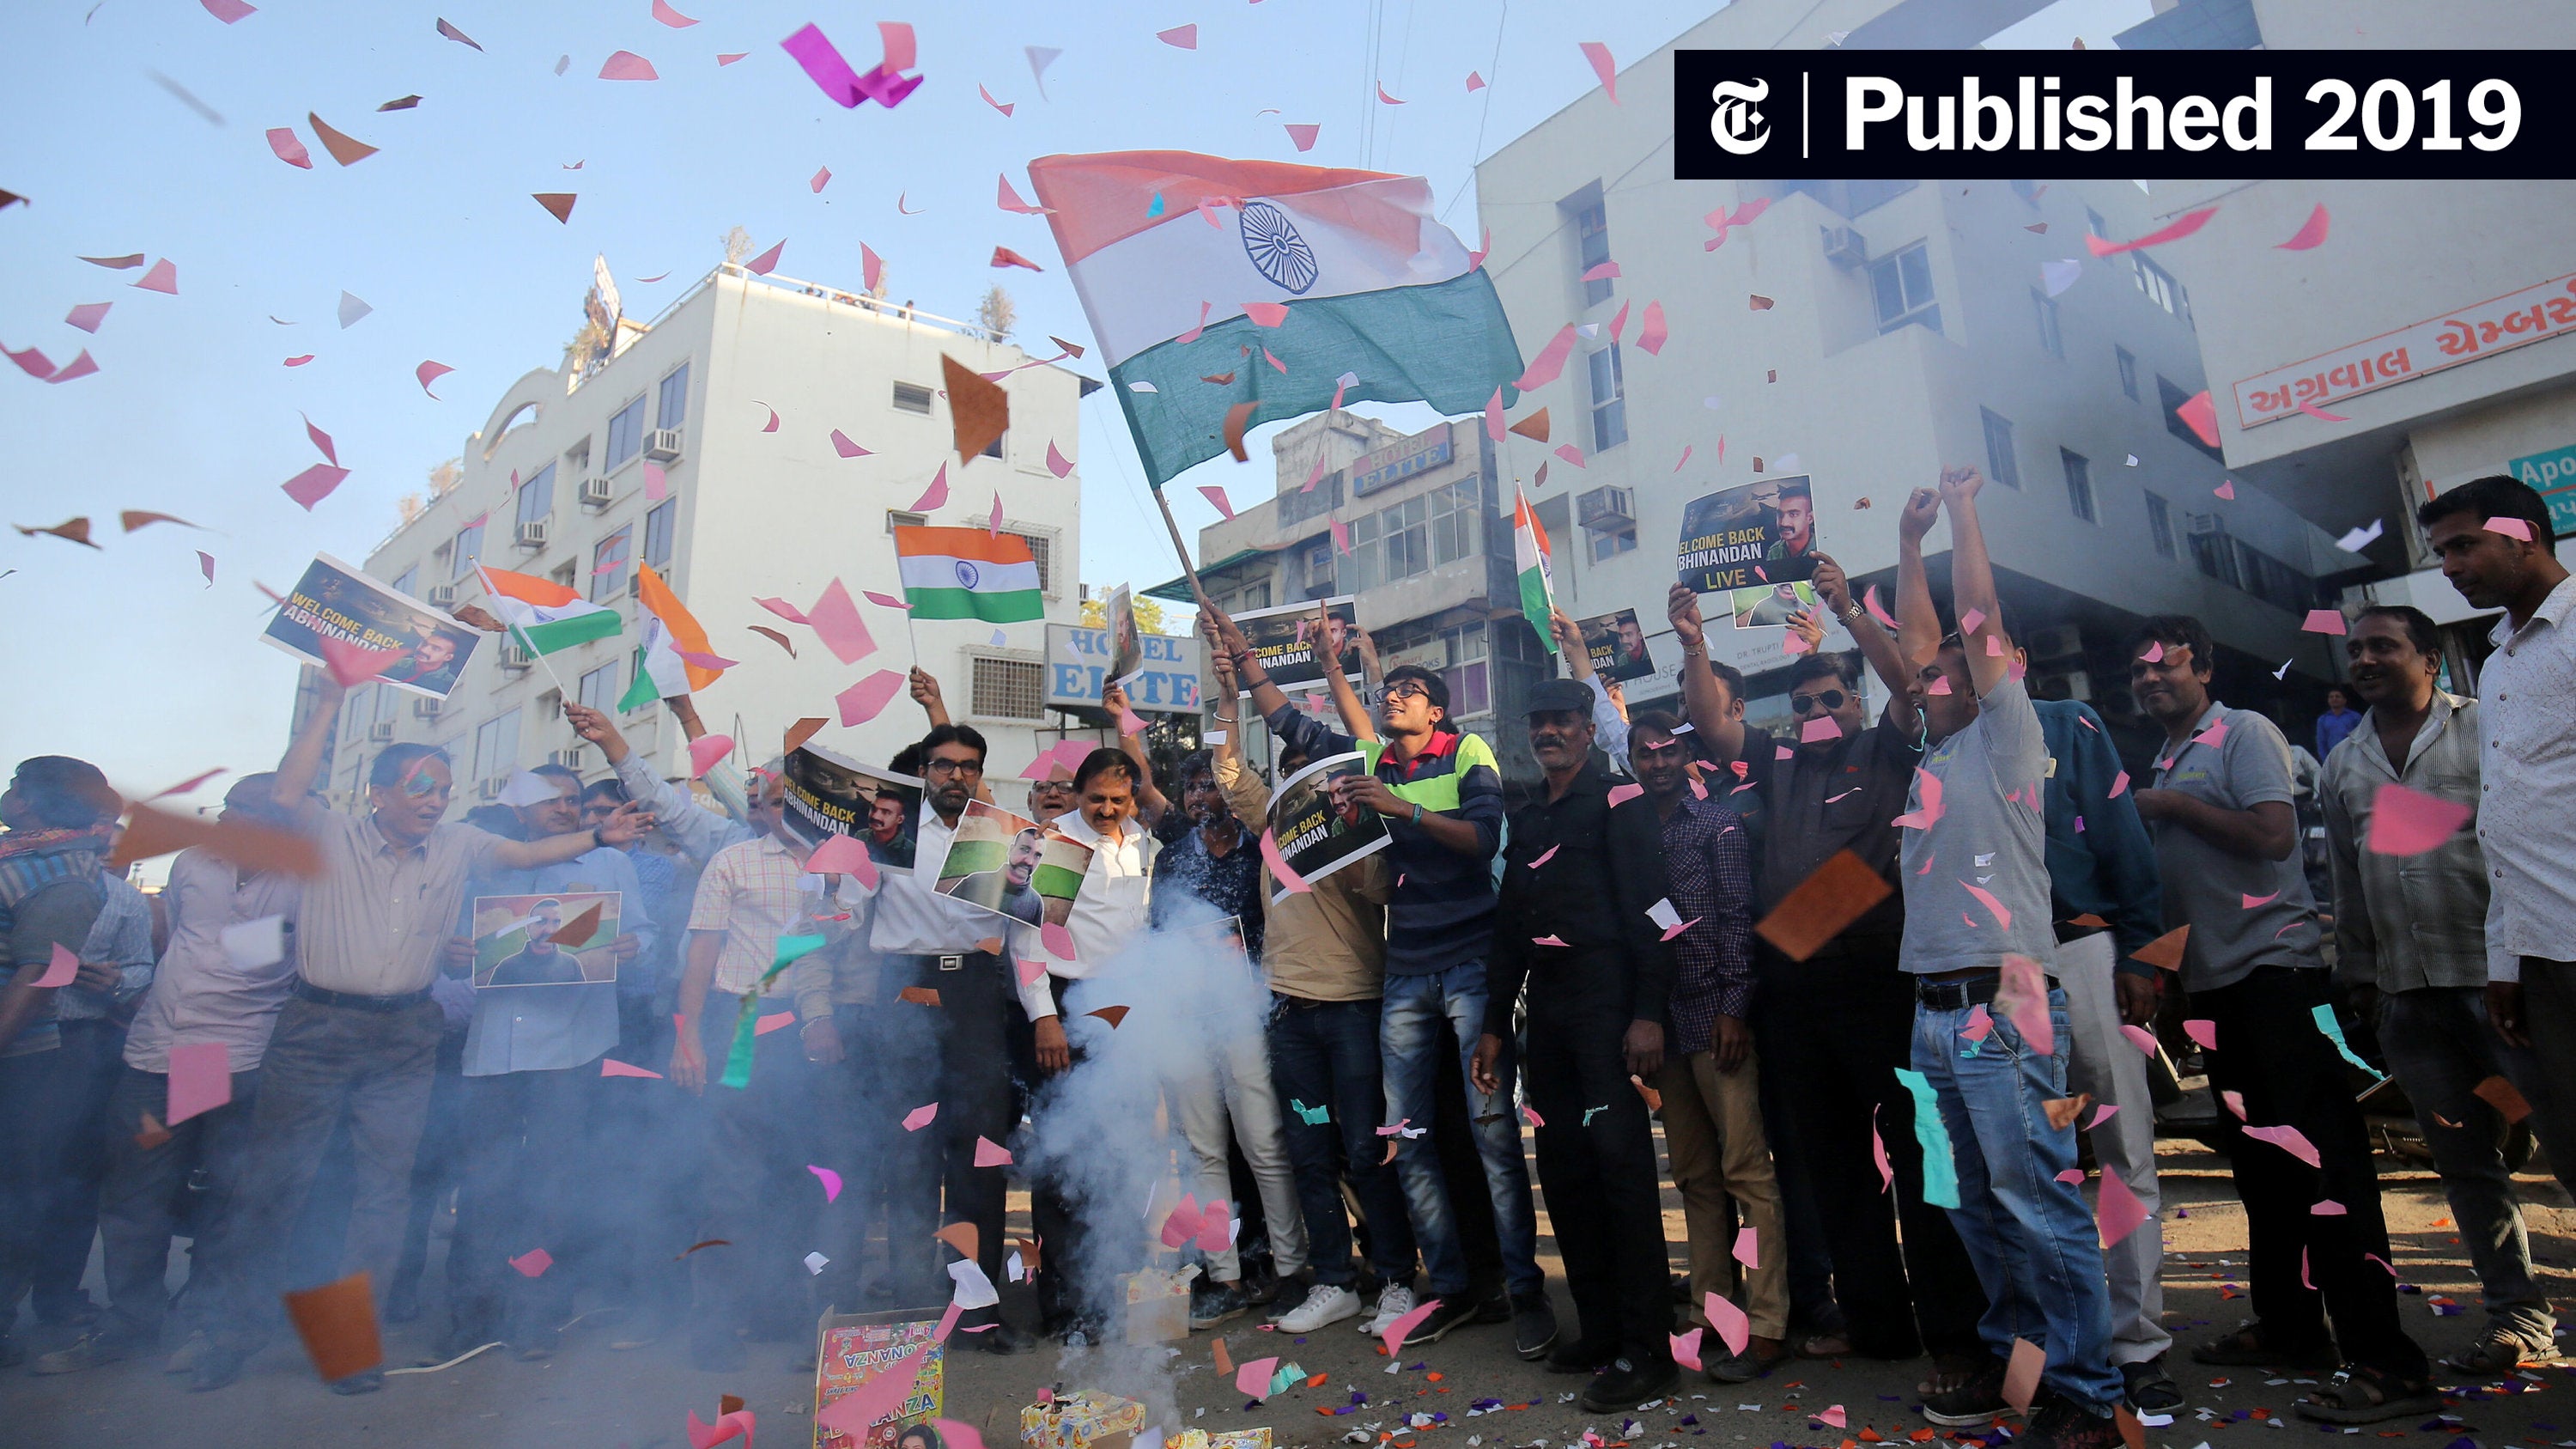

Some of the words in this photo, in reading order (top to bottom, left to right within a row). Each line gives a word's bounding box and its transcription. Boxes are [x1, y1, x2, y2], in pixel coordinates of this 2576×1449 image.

[1370, 435, 1432, 467] HOTEL
[1362, 447, 1442, 491] ELITE
[2521, 447, 2576, 487] Apo
[1679, 533, 1725, 555] ELCOME
[1728, 526, 1765, 545] BACK
[1678, 542, 1763, 571] BHINANDAN
[1705, 568, 1747, 590] LIVE
[283, 604, 393, 654] ABHINAND
[292, 592, 363, 636] WELCOME
[361, 628, 404, 650] BACK
[1070, 630, 1183, 663] HEL
[1255, 644, 1285, 659] COME
[1285, 641, 1313, 654] BACK
[1256, 650, 1312, 670] INANDAN
[1590, 644, 1614, 659] BACK
[1752, 642, 1780, 655] TRUPTI
[1052, 663, 1200, 708] ELTE
[1634, 663, 1676, 686] HOUSE
[783, 787, 850, 837] ABHINANDAN
[822, 801, 857, 824] BACK
[1278, 825, 1300, 849] COME
[1299, 809, 1327, 834] BACK
[1279, 823, 1329, 862] INANDAN
[843, 1342, 927, 1368] ONANZA
